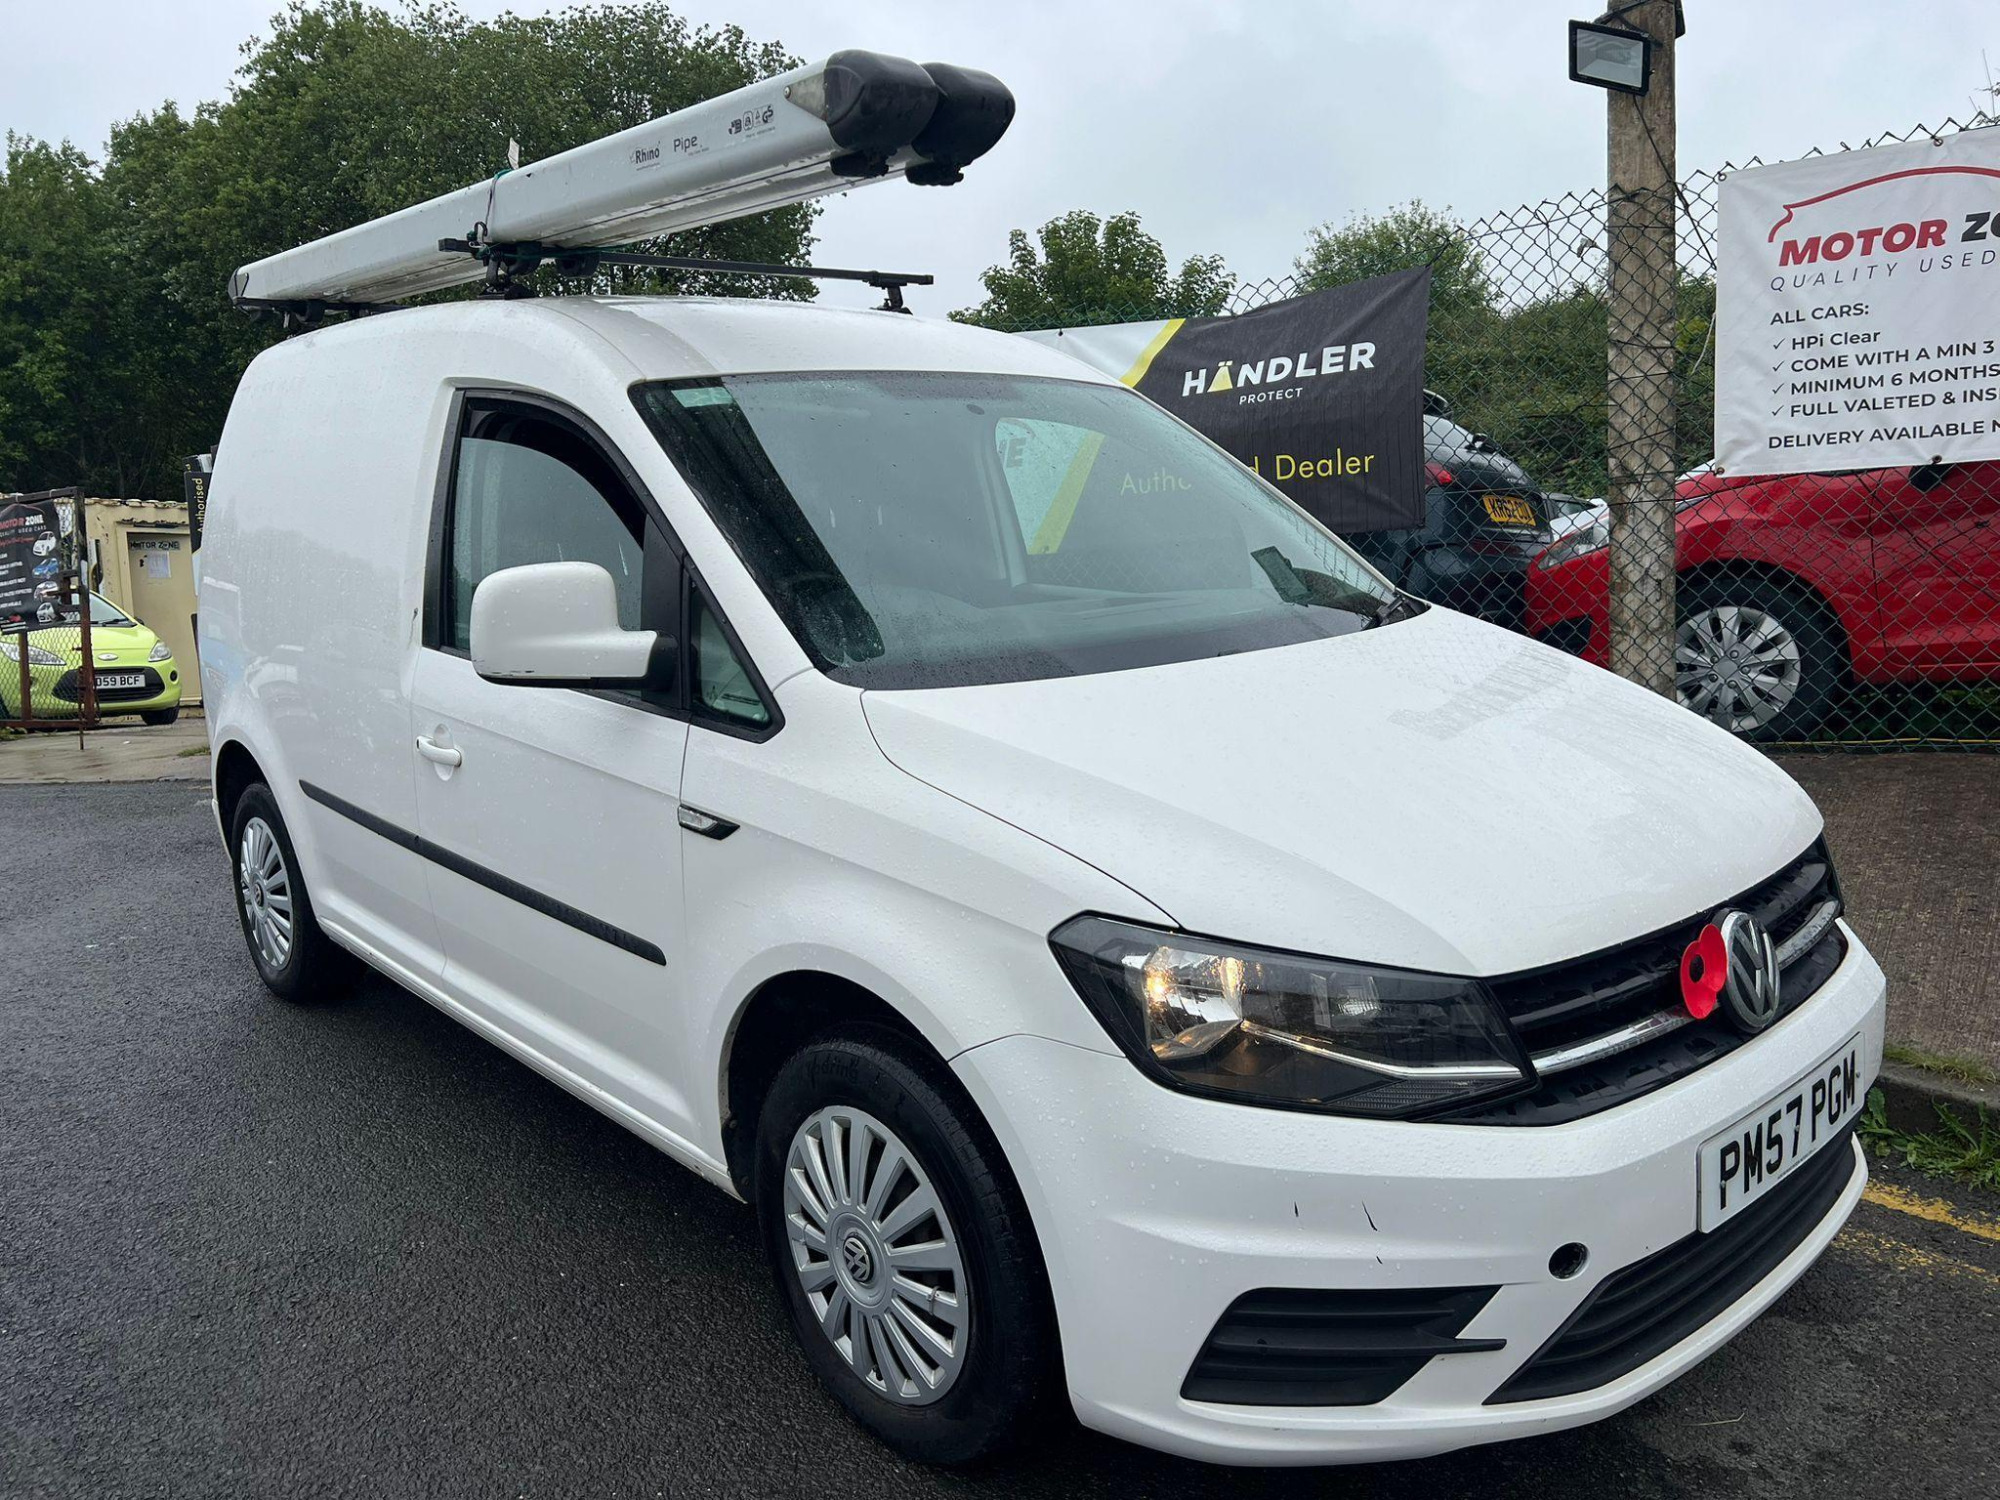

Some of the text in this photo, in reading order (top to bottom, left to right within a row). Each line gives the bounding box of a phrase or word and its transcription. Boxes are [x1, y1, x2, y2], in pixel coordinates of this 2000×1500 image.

[635, 147, 660, 164] Rhino
[673, 135, 698, 153] Pipe
[1778, 211, 2000, 267] MOTOR Z
[1770, 249, 1996, 291] QUALITY USED
[1769, 303, 1869, 325] ALL CARS:
[1791, 329, 1881, 350] HPi Clear
[1791, 340, 1995, 373] COME WITH A MIN 3
[1791, 363, 2000, 395] MINIMUM 6 MONTHS
[1239, 387, 1303, 405] PROTECT
[1790, 387, 2000, 417] FULL VALETED & INS
[1768, 429, 1864, 449] DELIVERY
[1869, 420, 1985, 441] AVAILABLE
[1276, 447, 1375, 482] Dealer
[25, 514, 44, 526] ZONE
[120, 675, 140, 686] BCF
[1719, 1049, 1856, 1211] PM57 PGM
